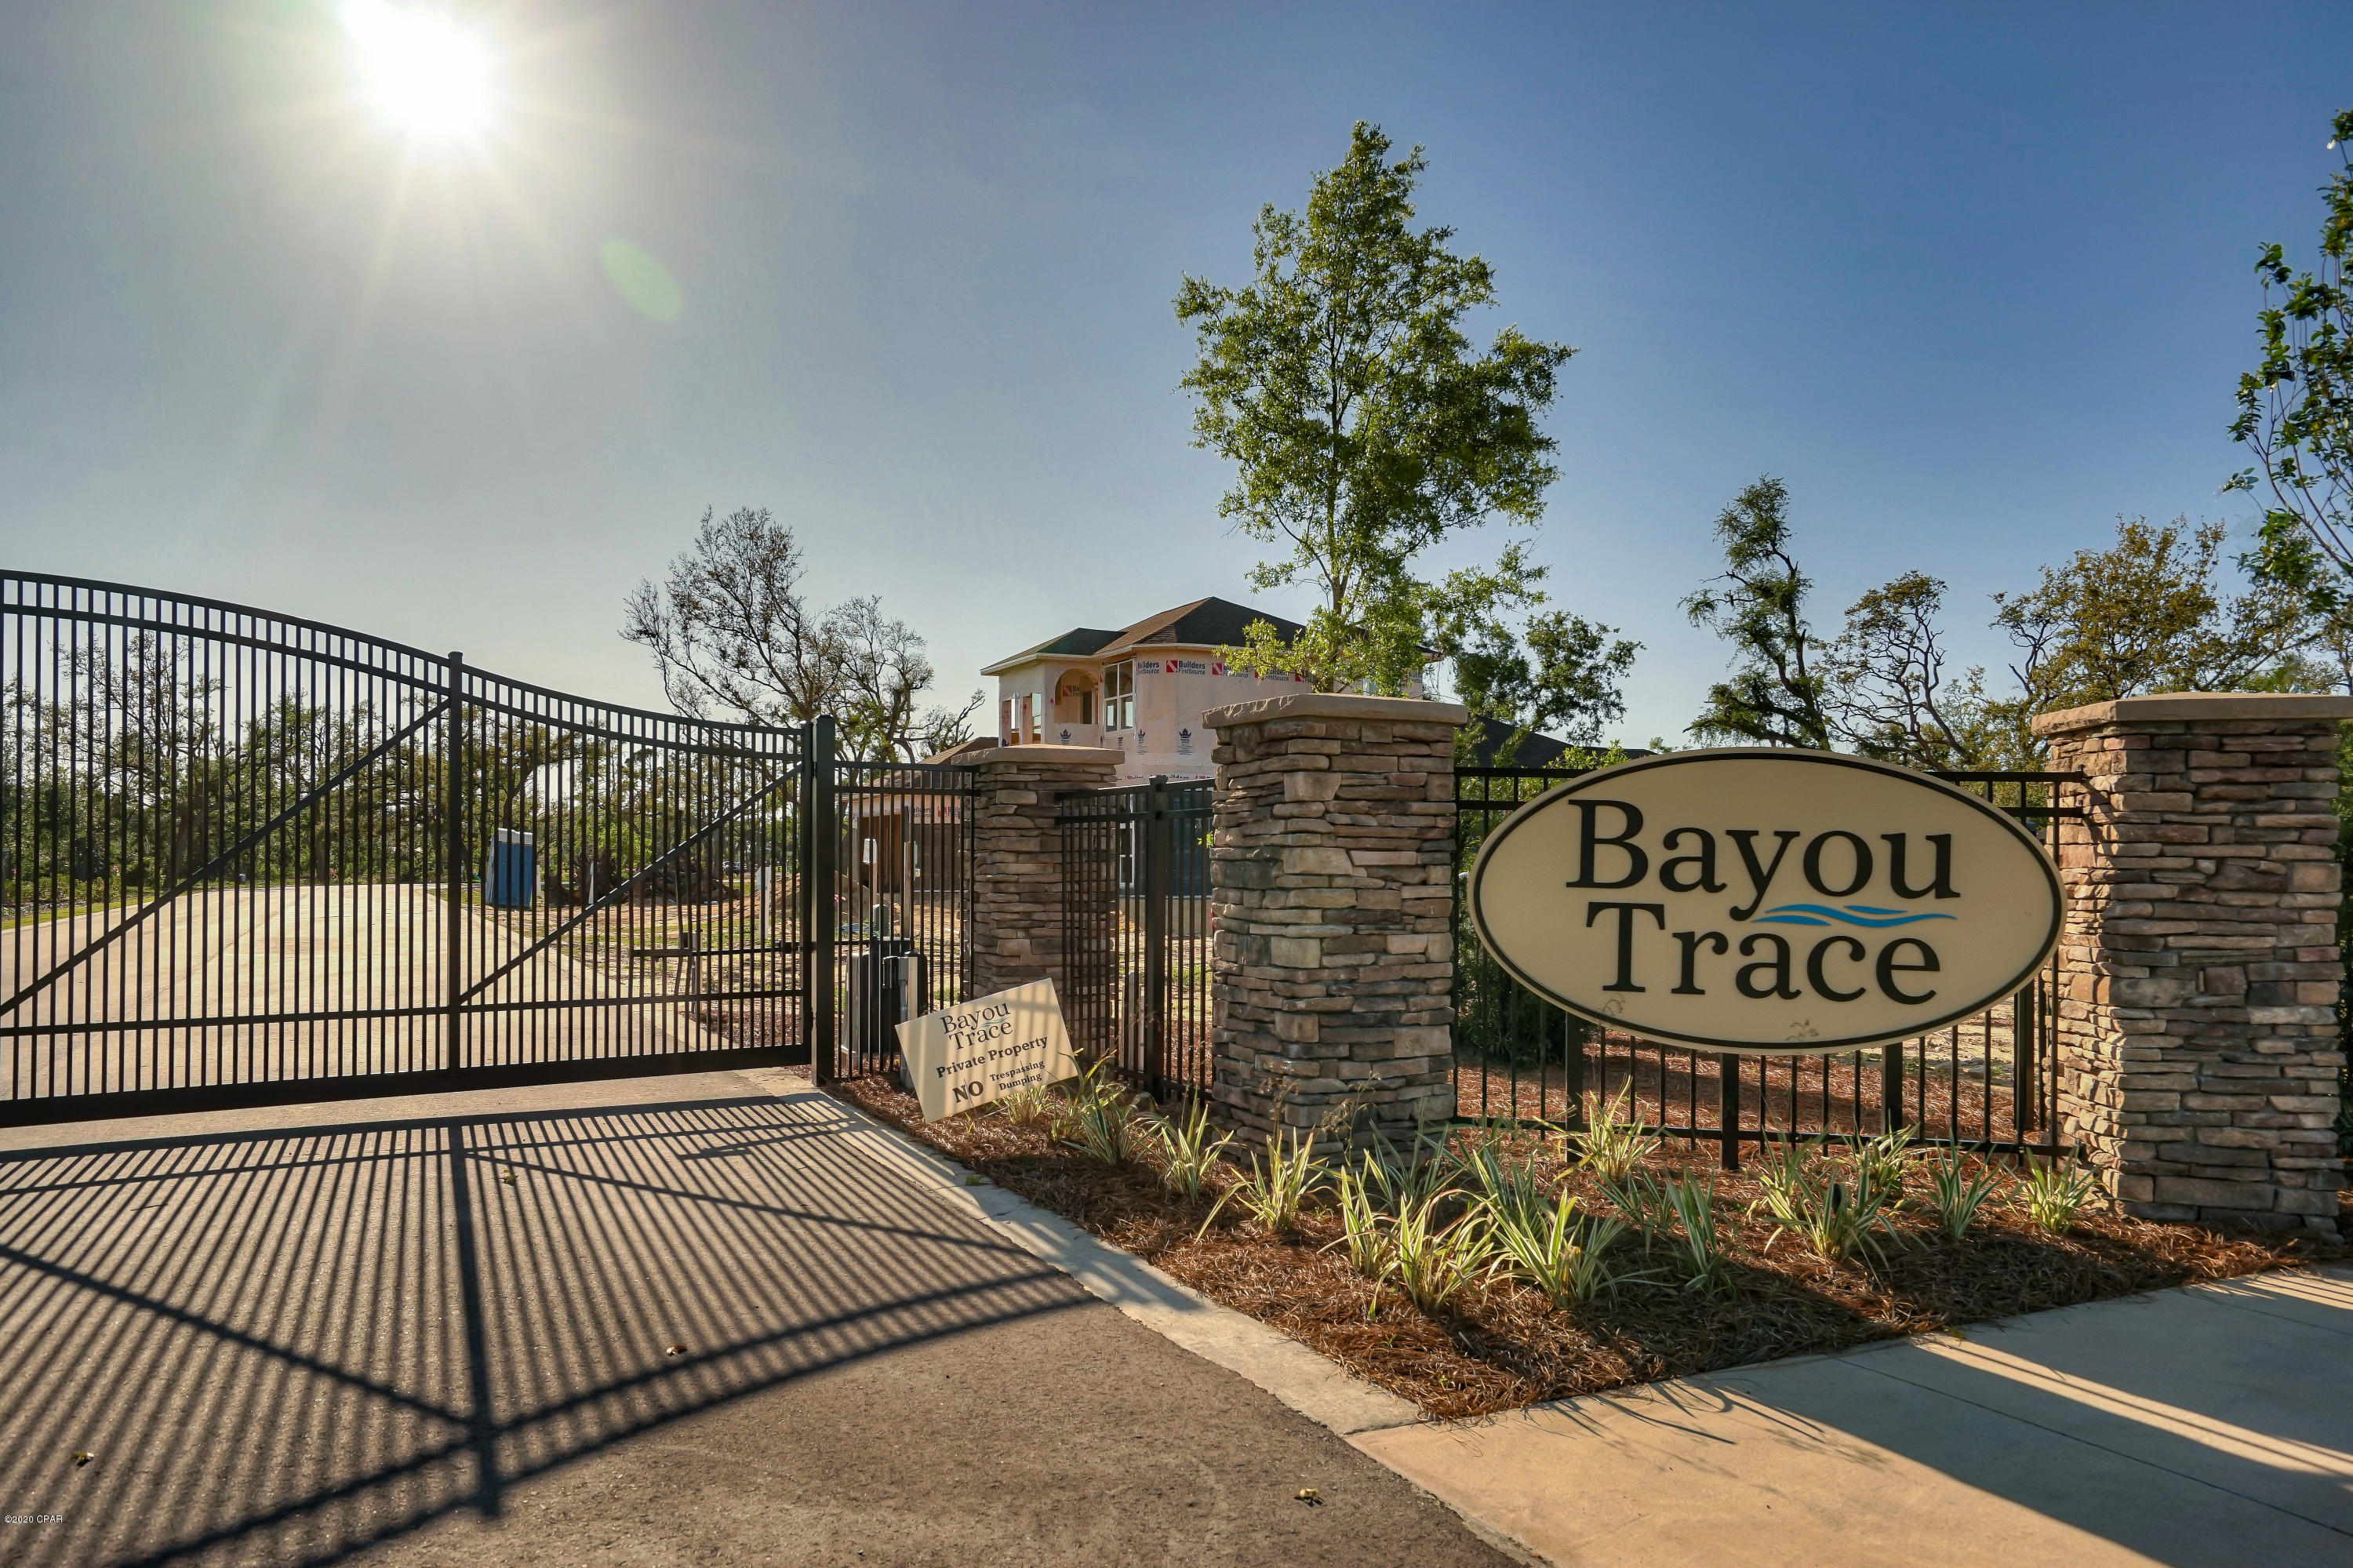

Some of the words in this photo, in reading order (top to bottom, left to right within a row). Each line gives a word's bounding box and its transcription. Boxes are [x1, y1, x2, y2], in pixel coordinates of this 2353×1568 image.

[1178, 660, 1206, 669] Builders
[1566, 799, 1961, 922] Bayou
[1586, 901, 1941, 1005] Trace
[940, 1002, 1011, 1034] Bayou
[949, 1021, 1013, 1050] Trace
[936, 1054, 986, 1078] Private
[988, 1036, 1048, 1061] Property
[989, 1060, 1045, 1082] Trespassing
[952, 1080, 984, 1103] NO
[998, 1073, 1042, 1091] Dumping
